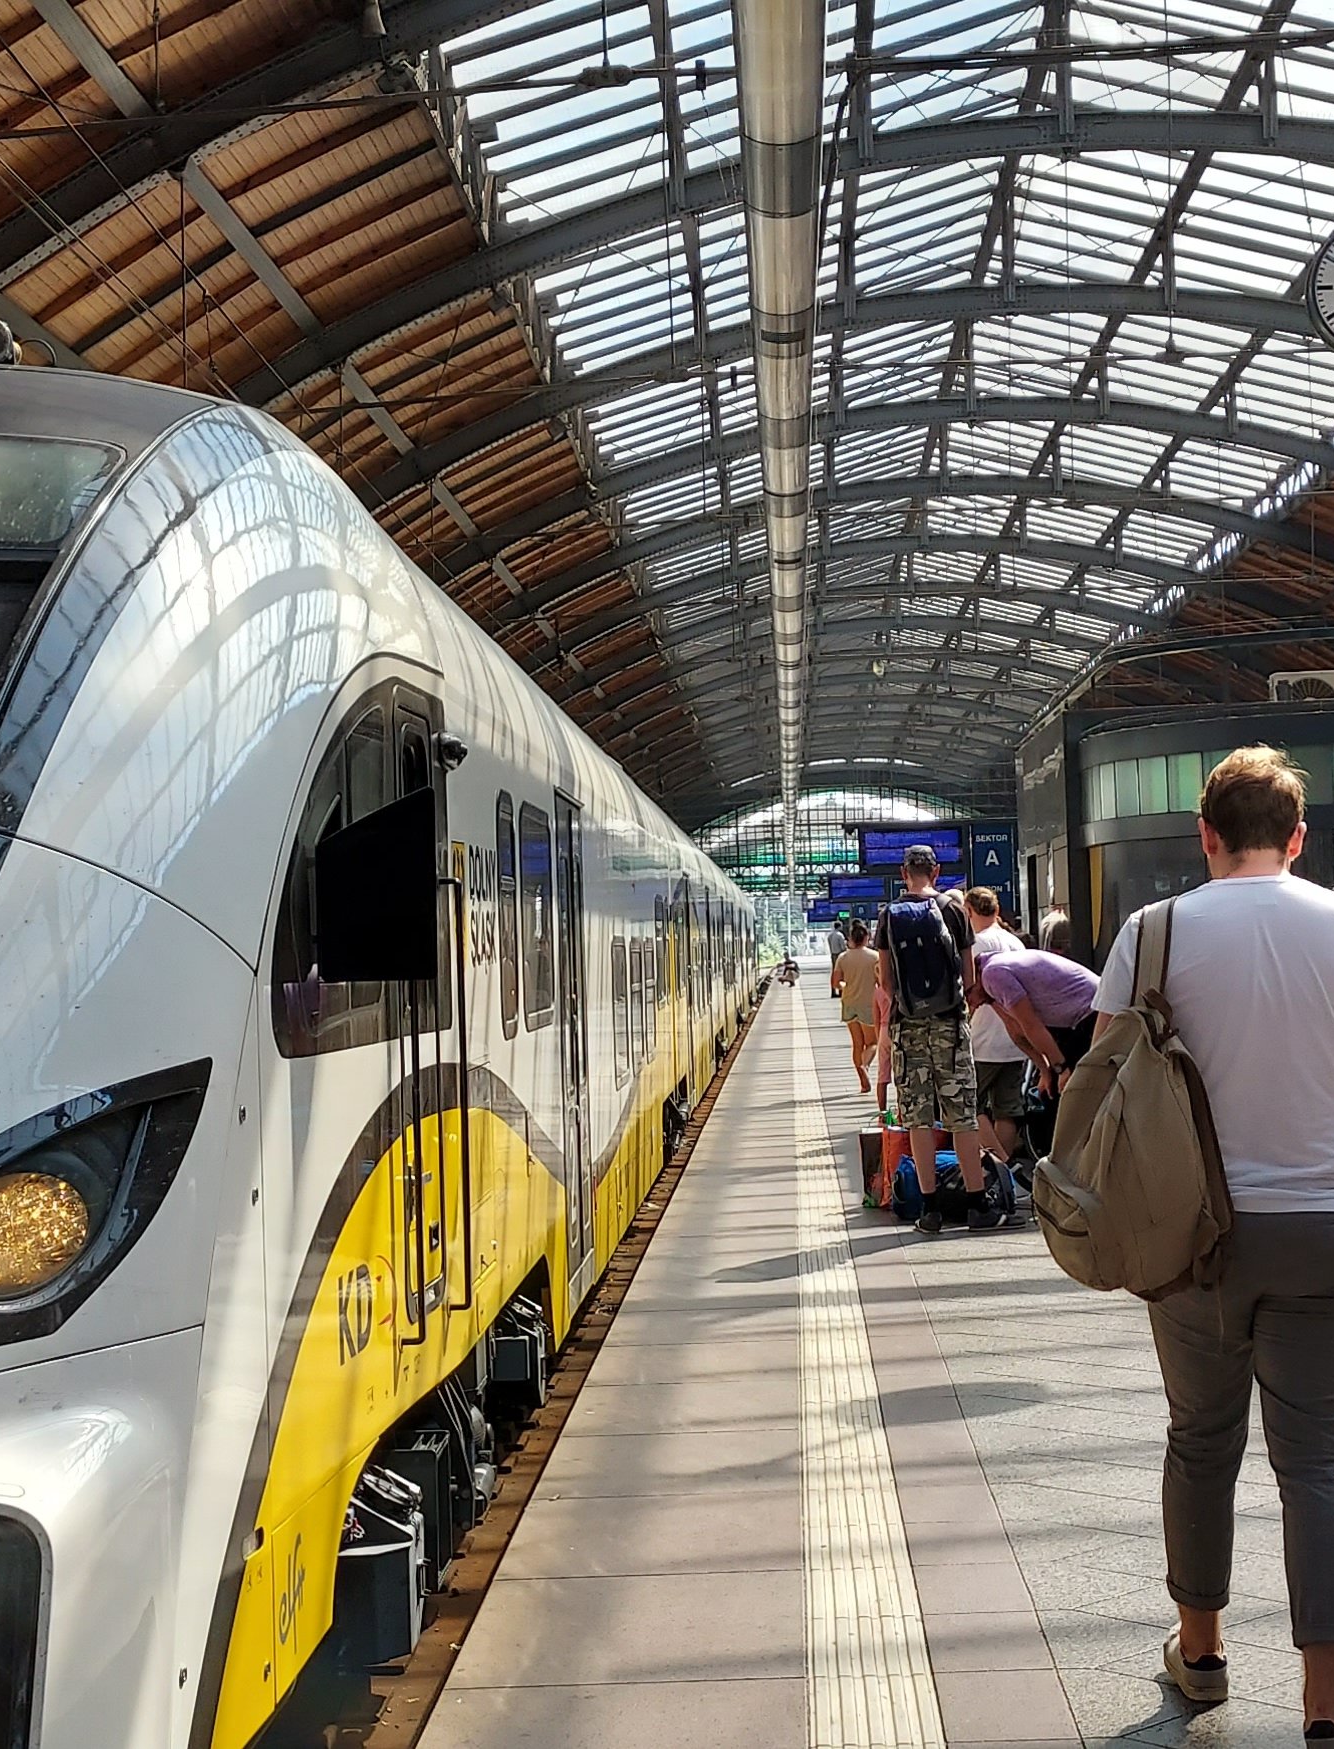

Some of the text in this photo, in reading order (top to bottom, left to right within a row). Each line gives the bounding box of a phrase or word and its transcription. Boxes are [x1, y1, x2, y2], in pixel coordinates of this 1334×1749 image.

[975, 834, 1008, 843] SEKTOR
[468, 844, 496, 902] DOLNY
[985, 850, 999, 866] A
[1005, 881, 1011, 892] 1
[470, 897, 497, 974] ŚLĄSK
[338, 1263, 373, 1366] KD
